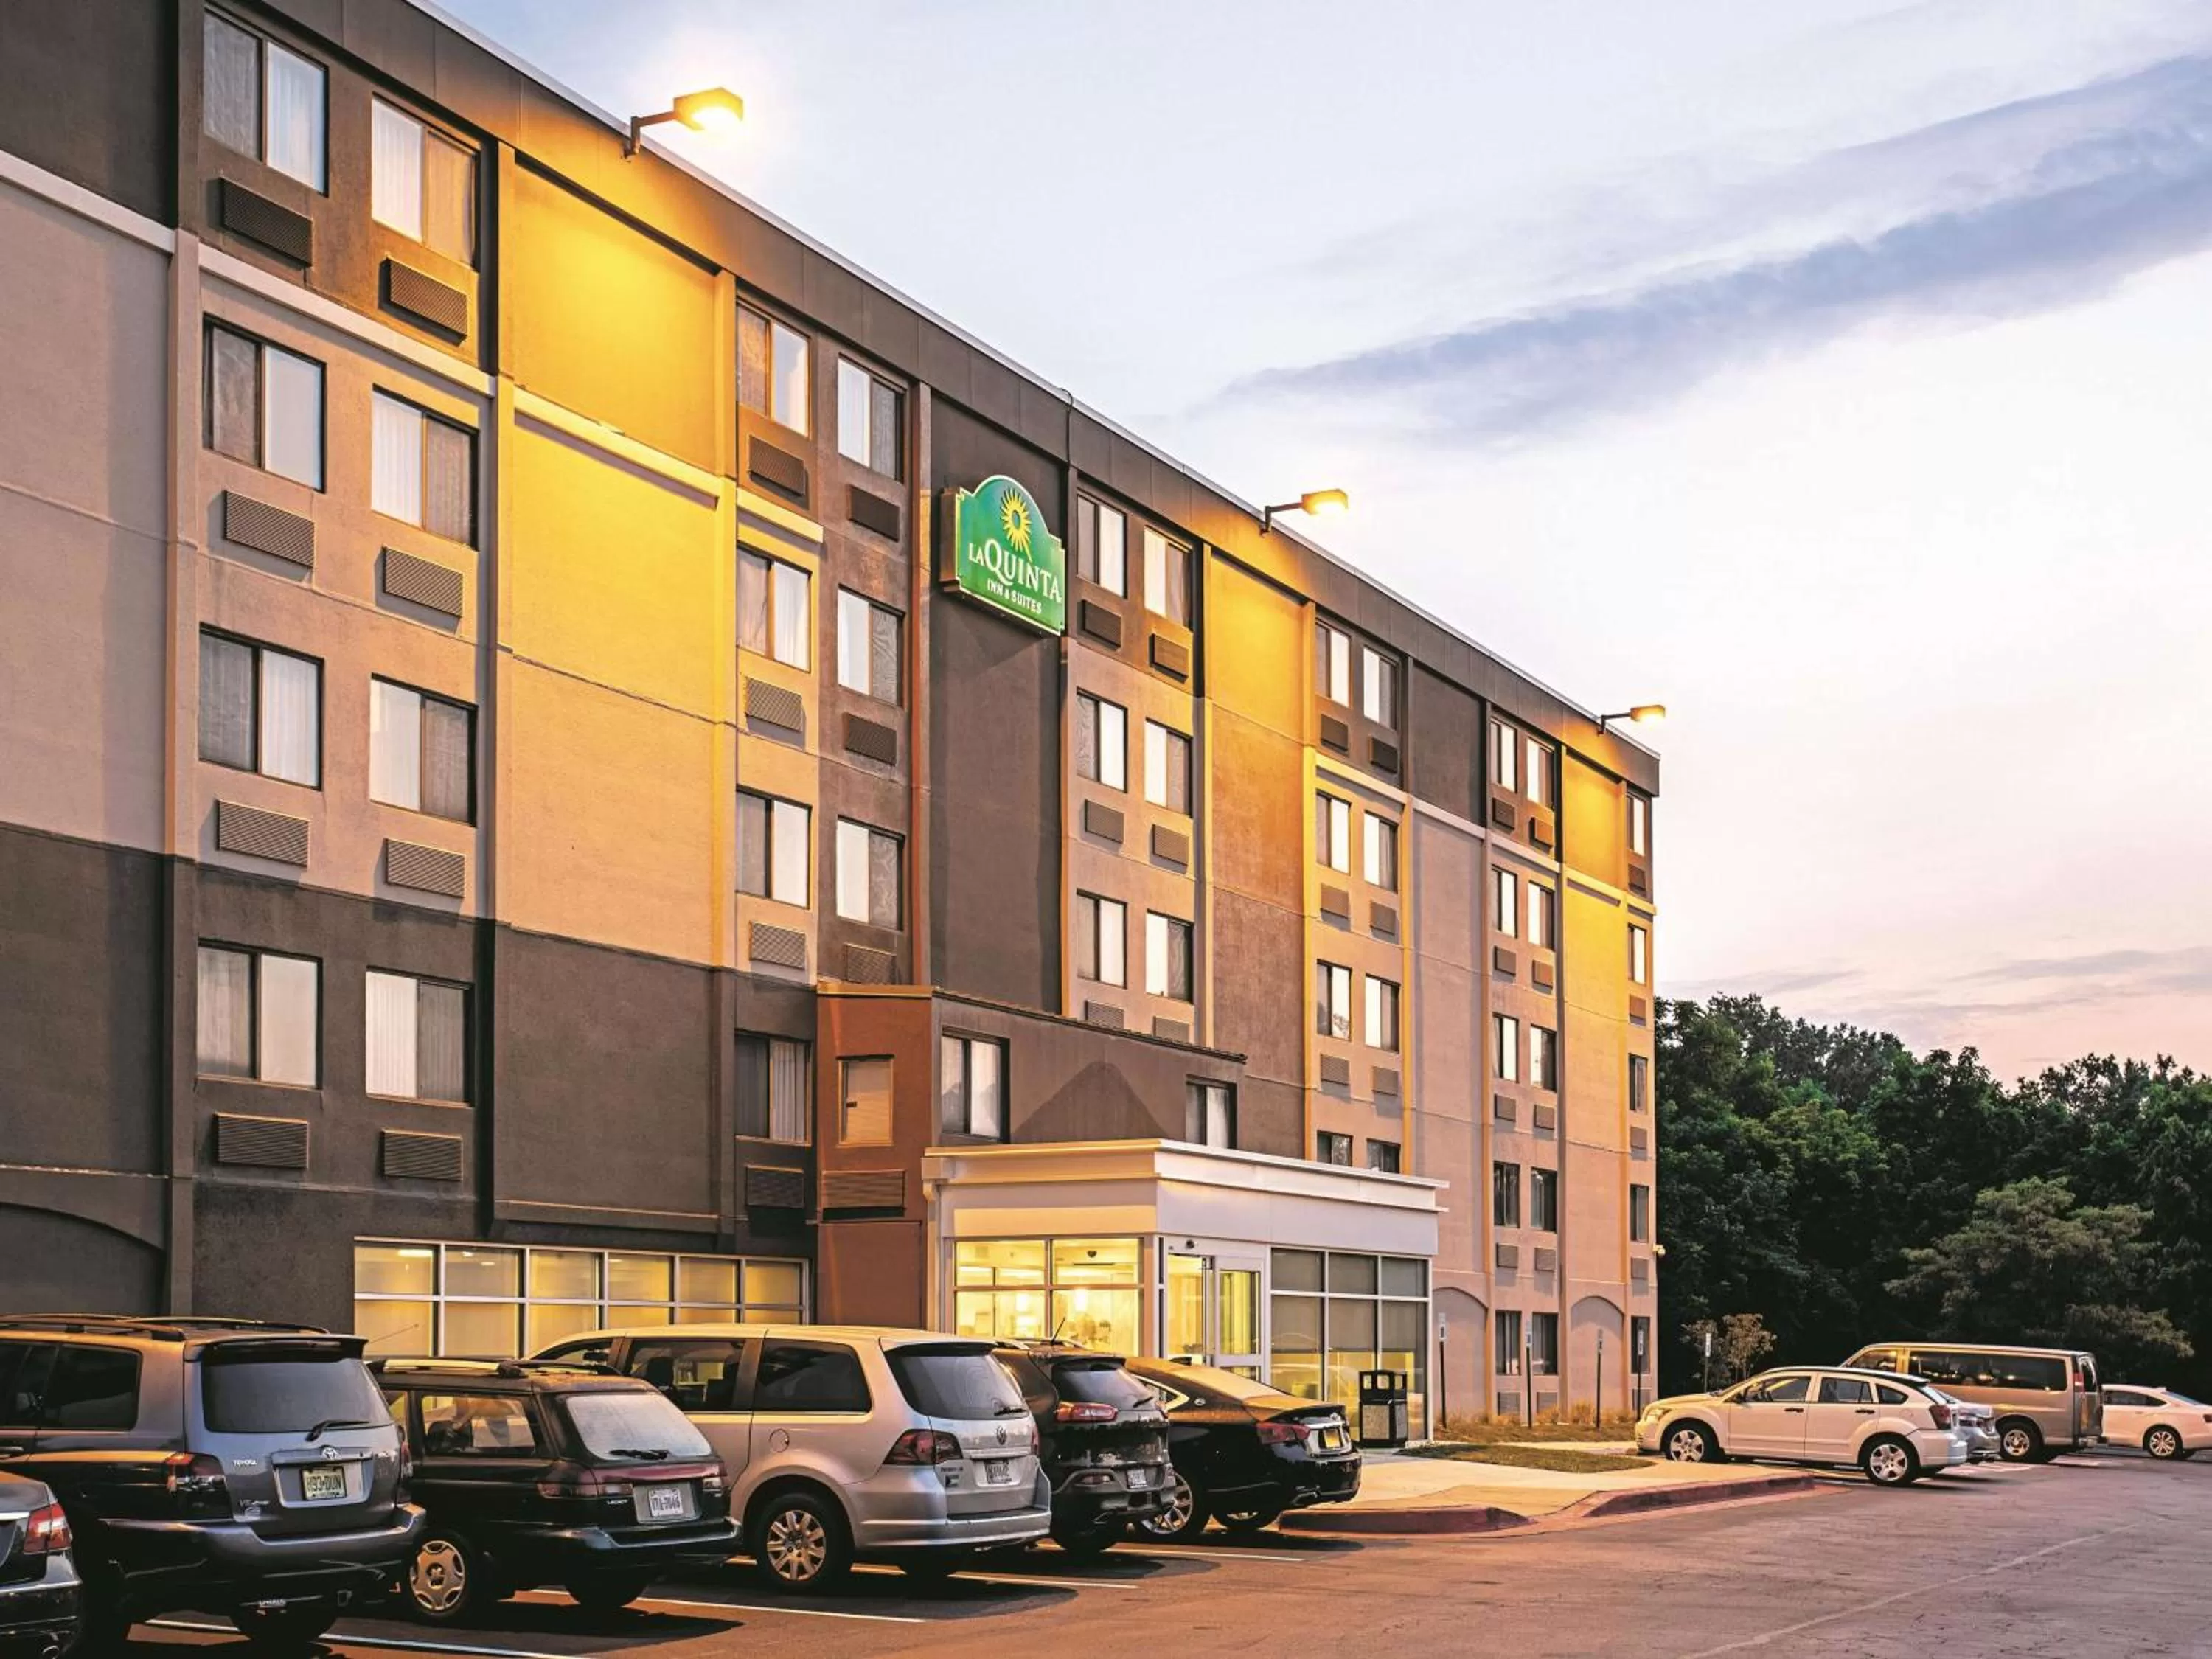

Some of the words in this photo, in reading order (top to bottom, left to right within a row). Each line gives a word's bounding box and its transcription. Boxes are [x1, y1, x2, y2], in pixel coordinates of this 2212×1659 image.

[968, 542, 985, 567] LA
[984, 539, 1062, 603] QUINTA
[988, 578, 1004, 597] INN
[1011, 590, 1042, 614] SUITES
